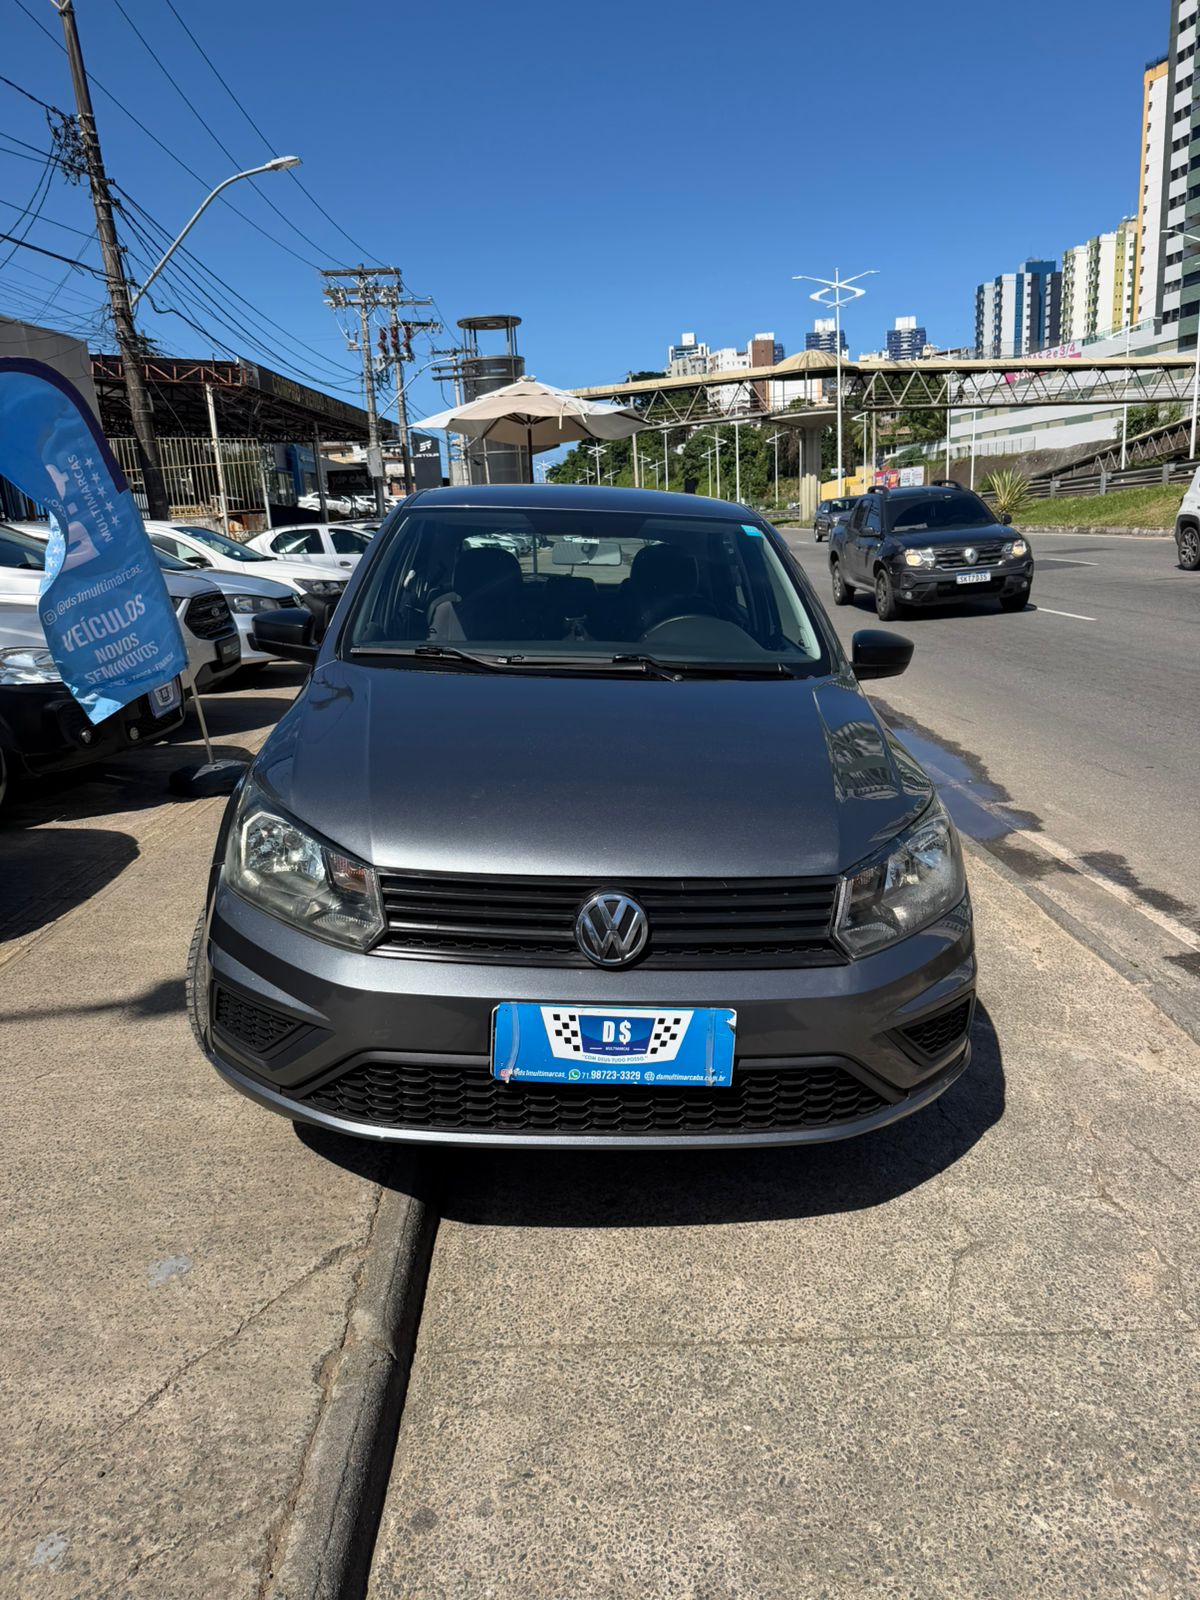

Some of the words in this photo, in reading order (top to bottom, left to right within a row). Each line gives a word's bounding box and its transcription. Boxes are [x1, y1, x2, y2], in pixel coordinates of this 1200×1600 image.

[68, 454, 113, 542] MULTIMARCAS
[61, 593, 146, 653] VEÍCULOS
[94, 632, 140, 664] NOVOS
[84, 641, 159, 684] SEMINOVOS
